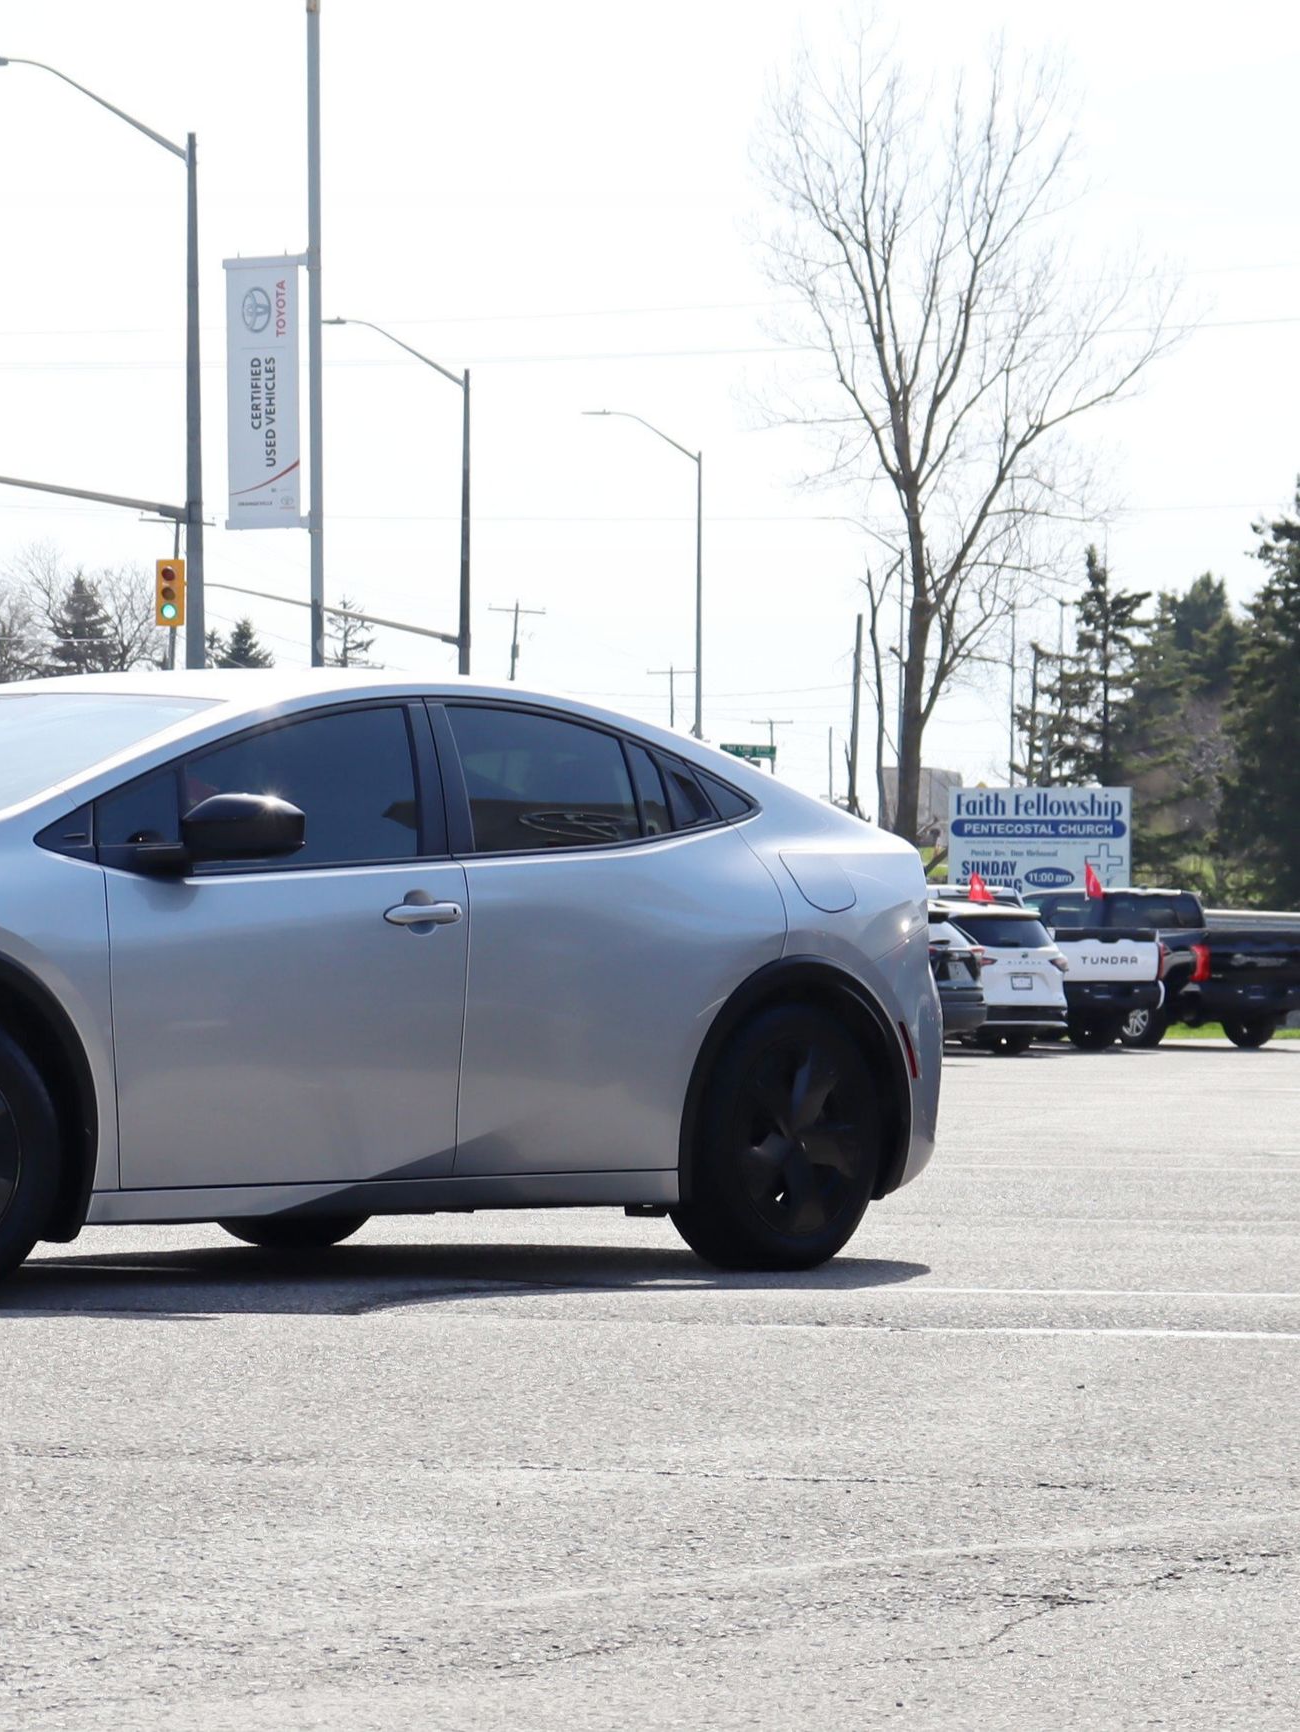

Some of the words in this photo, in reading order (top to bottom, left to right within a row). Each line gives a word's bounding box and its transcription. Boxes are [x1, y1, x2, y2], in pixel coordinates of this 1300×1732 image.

[276, 280, 287, 338] TOYOTA
[251, 357, 262, 430] CERTIFIED
[265, 356, 276, 426] VEHICLES
[265, 429, 276, 468] USED
[956, 793, 1006, 816] Faith
[1014, 793, 1123, 820] Fellowship
[963, 823, 1055, 835] PENTECOSTAL
[1058, 824, 1114, 835] CHURCH
[961, 860, 1017, 876] SUNDAY
[1028, 872, 1054, 883] 11:00
[1055, 874, 1072, 883] am
[956, 878, 1023, 894] NING
[1081, 956, 1139, 965] TUNDRA
